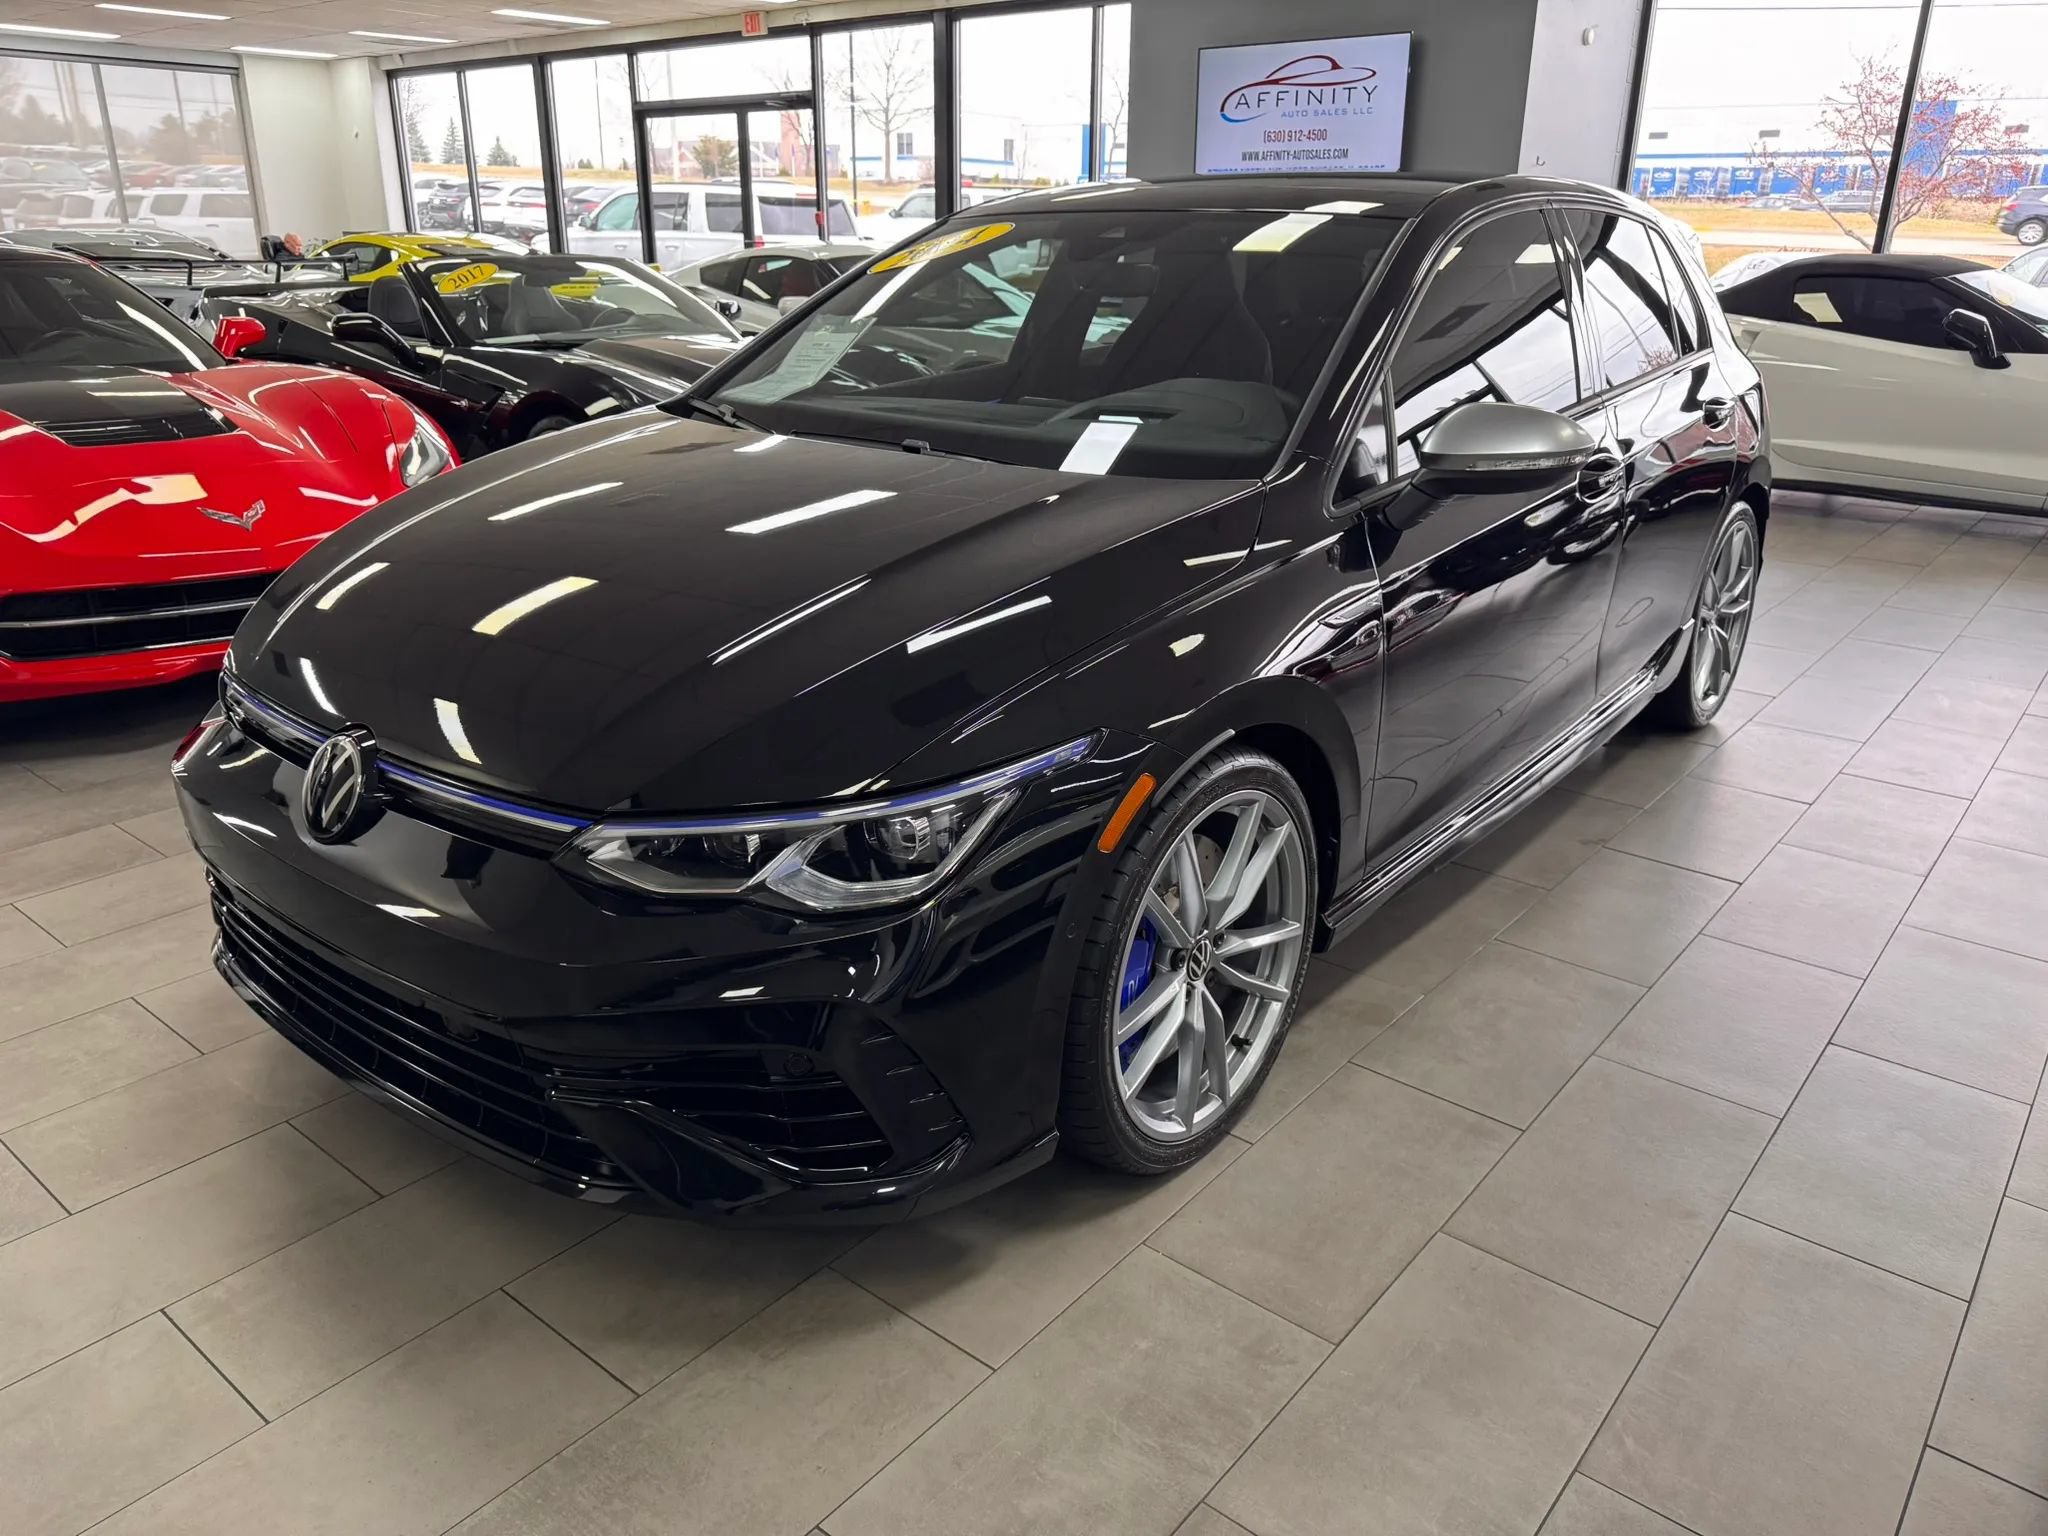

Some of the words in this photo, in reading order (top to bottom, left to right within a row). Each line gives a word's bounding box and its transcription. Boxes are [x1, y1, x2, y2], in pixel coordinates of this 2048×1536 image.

[744, 14, 760, 32] EXIT
[1234, 85, 1378, 109] AFFINITY
[1281, 110, 1308, 118] AUTO
[1313, 108, 1348, 117] SALES
[1353, 107, 1374, 115] LLC
[1287, 129, 1328, 142] 912-4500
[1241, 148, 1349, 162] WWW.AFFINITY-AUTOSALES.COM
[448, 265, 484, 289] 2017
